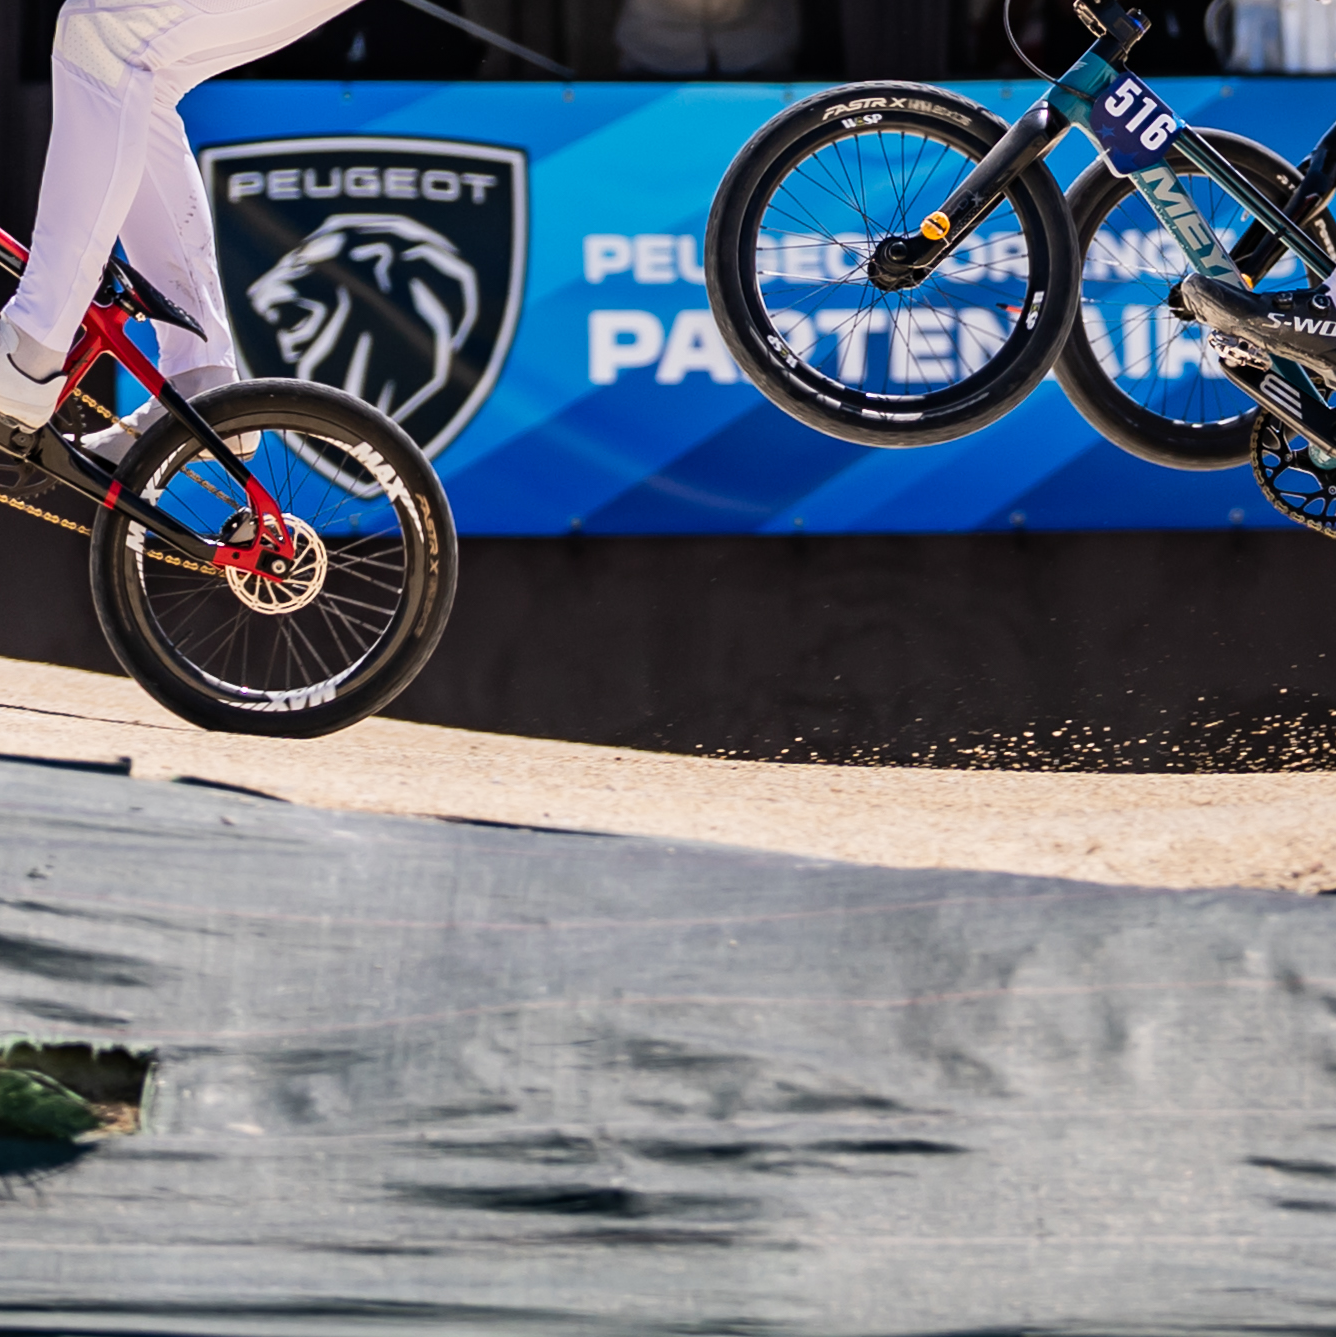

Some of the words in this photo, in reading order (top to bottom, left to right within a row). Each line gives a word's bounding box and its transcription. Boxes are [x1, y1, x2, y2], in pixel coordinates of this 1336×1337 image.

[822, 97, 887, 121] FASTR
[889, 97, 908, 108] X
[1104, 78, 1176, 151] 516
[226, 166, 497, 204] PEUGEOT
[1140, 166, 1244, 289] MEY
[581, 232, 915, 286] PEUEO
[350, 441, 405, 502] MAX
